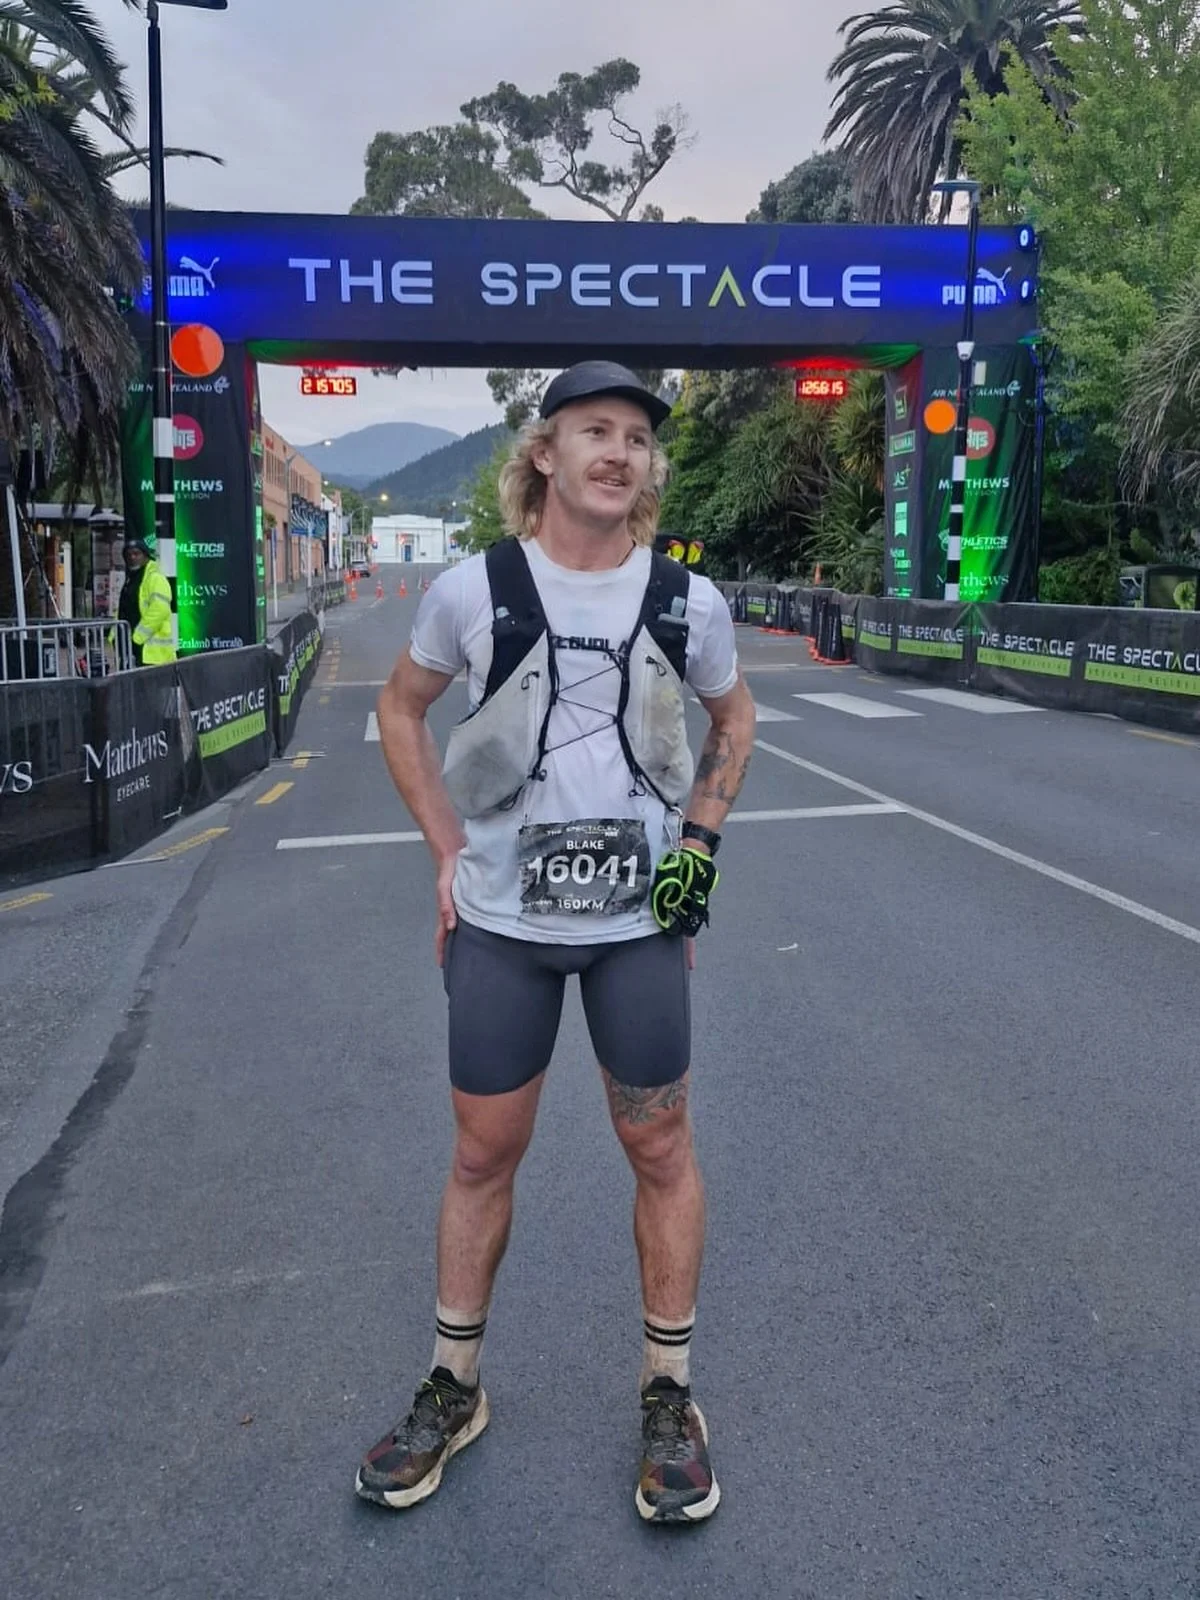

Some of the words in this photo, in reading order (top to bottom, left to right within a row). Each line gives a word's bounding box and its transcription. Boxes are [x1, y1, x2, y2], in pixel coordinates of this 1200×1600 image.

[288, 258, 433, 304] THE
[480, 262, 881, 308] SPECTACLE
[141, 479, 224, 491] MTHEWS
[938, 477, 1010, 491] MTHEWS
[899, 624, 913, 639] THE
[915, 625, 964, 642] SPECTACLE
[980, 631, 1000, 647] THE
[1003, 634, 1076, 656] SPECTACLE
[1087, 643, 1117, 662] THE
[190, 705, 212, 732] THE
[213, 687, 266, 725] SPECTACLE
[82, 726, 169, 783] Matthews
[116, 774, 151, 802] EYECARE
[566, 839, 605, 850] BLAKE
[527, 854, 639, 888] 16041
[557, 898, 605, 911] 160KM
